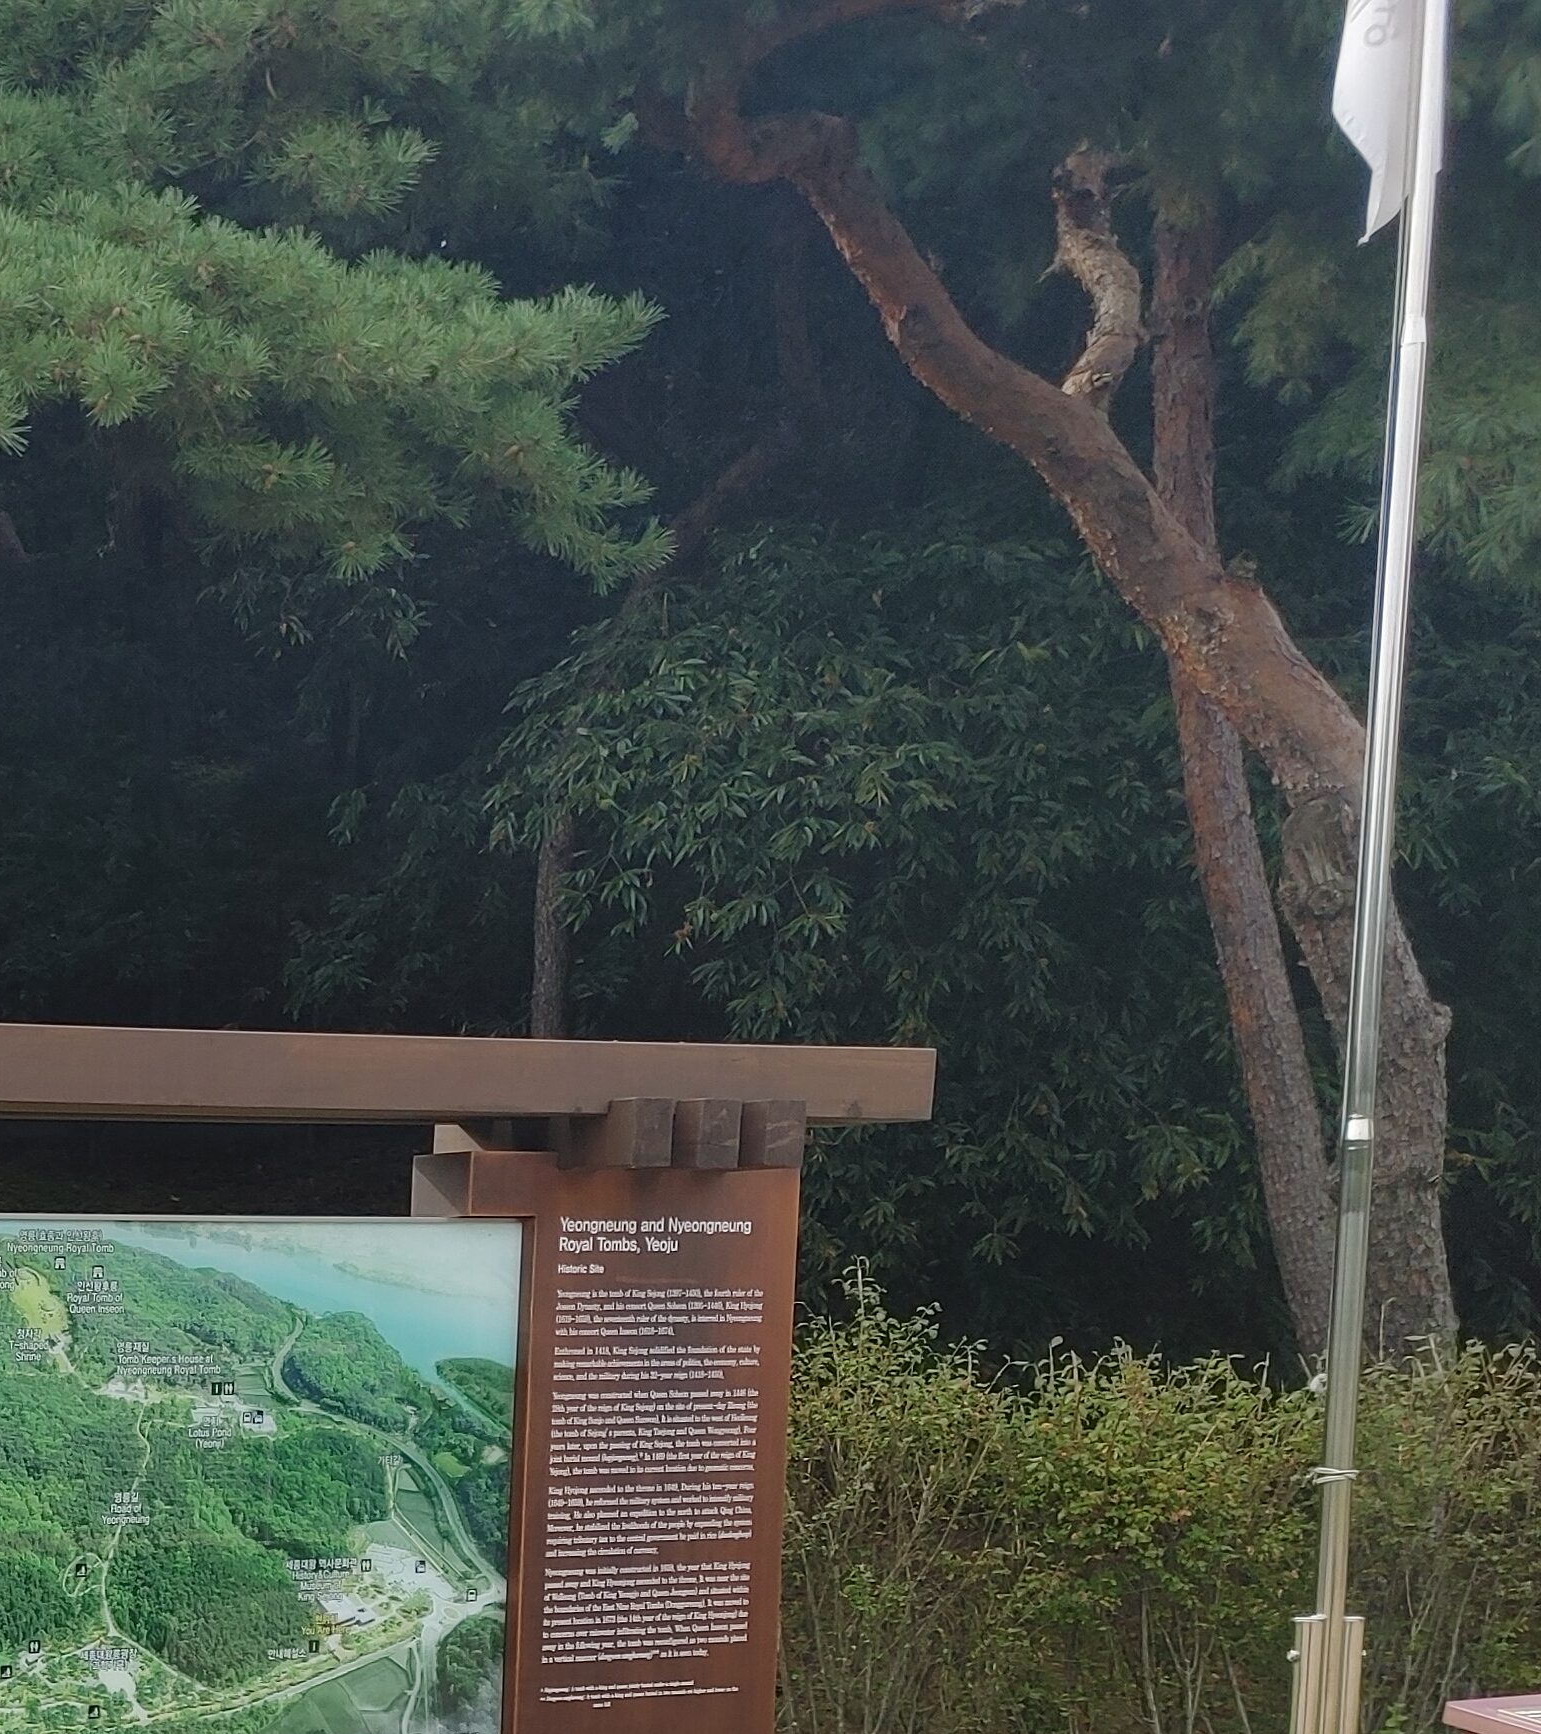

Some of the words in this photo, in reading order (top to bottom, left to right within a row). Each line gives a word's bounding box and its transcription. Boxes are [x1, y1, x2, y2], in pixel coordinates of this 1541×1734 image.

[560, 1216, 637, 1234] Yeongneung
[640, 1217, 665, 1233] and
[668, 1217, 752, 1235] Nyeongneung
[66, 1242, 90, 1254] Royal
[91, 1242, 115, 1253] Tomb
[559, 1237, 593, 1254] Royal
[597, 1237, 641, 1254] Tombs,
[645, 1237, 679, 1254] Yeoju
[9, 1268, 18, 1278] of
[557, 1264, 587, 1274] Historic
[589, 1264, 605, 1274] Site
[67, 1293, 90, 1304] Royal
[91, 1293, 112, 1303] Tomb
[114, 1292, 124, 1303] of
[69, 1303, 95, 1315] Queen
[98, 1303, 125, 1314] Inseon
[9, 1340, 49, 1352] T-shaped
[15, 1351, 42, 1361] Shrine
[118, 1354, 139, 1364] Tomb
[178, 1354, 204, 1364] House
[174, 1365, 197, 1376] Royal
[199, 1365, 221, 1374] Tomb
[212, 1428, 232, 1437] Pond
[297, 1592, 316, 1603] King
[301, 1625, 315, 1635] You
